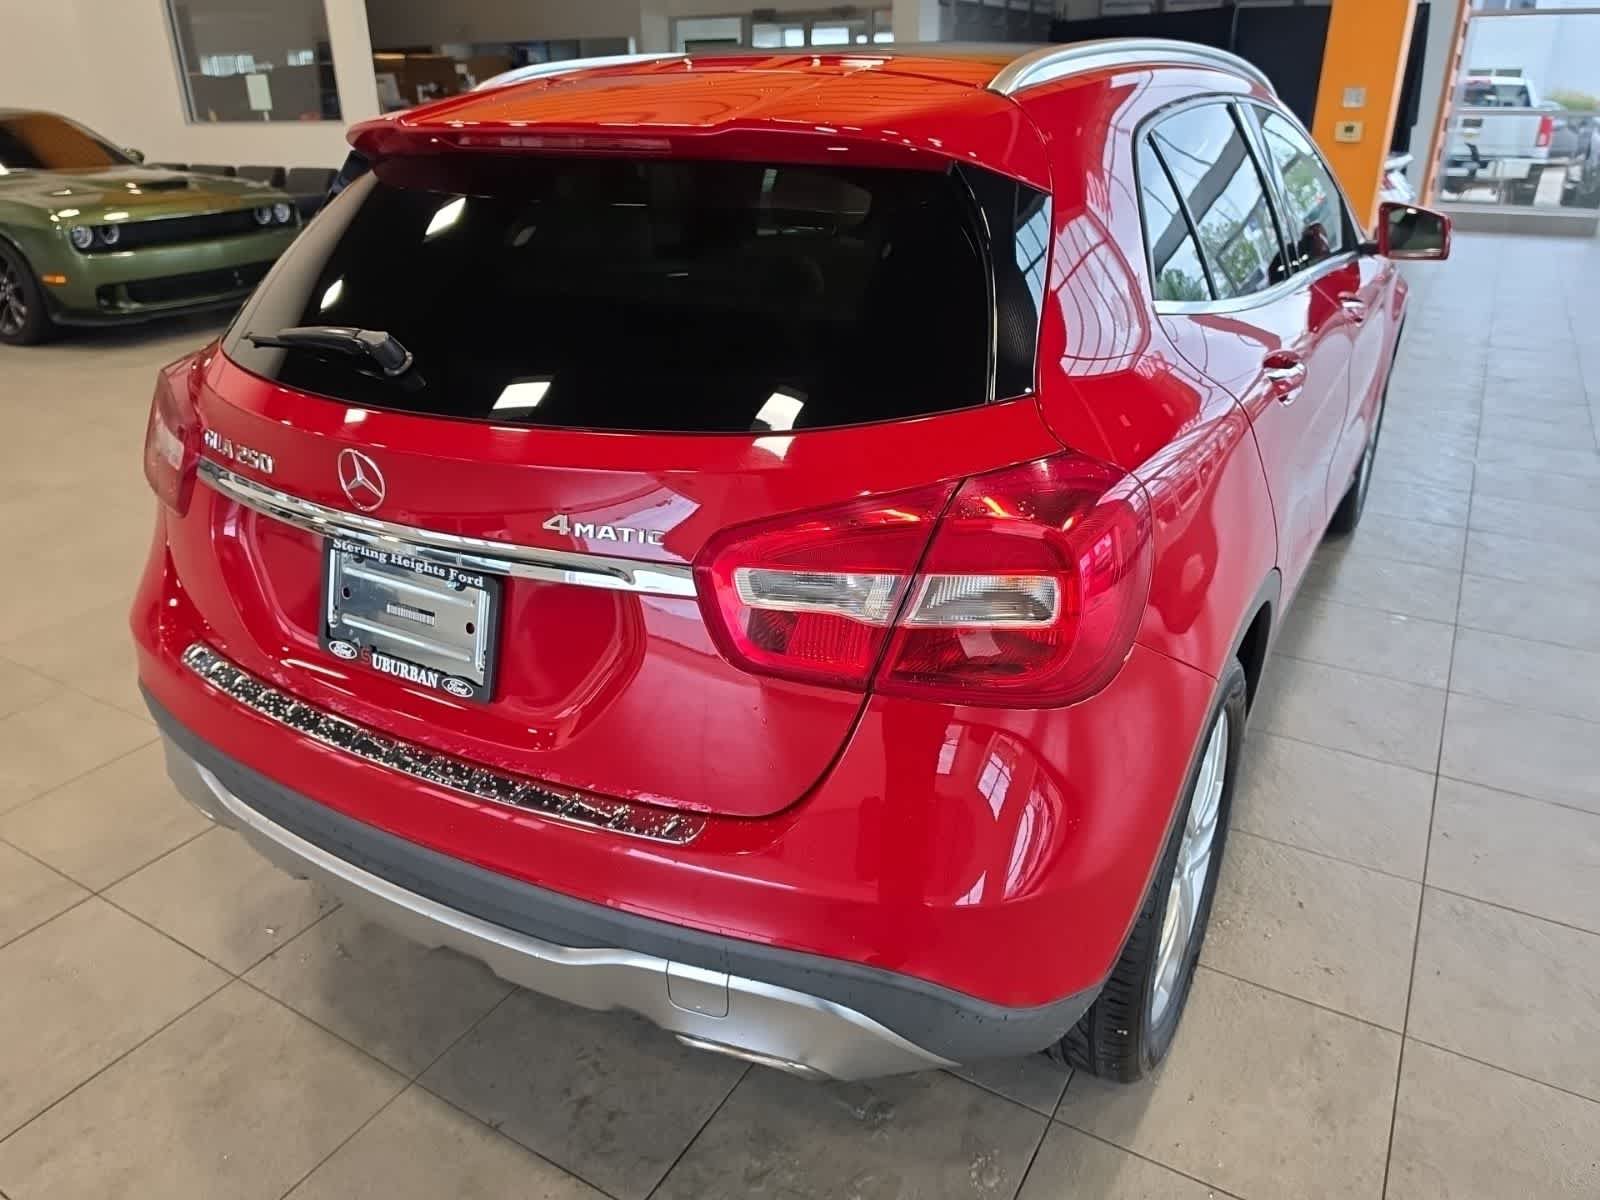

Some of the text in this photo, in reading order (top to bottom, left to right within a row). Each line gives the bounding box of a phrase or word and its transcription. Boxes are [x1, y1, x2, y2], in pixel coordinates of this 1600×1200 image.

[236, 445, 273, 474] 250
[542, 514, 666, 546] 4MATIC
[332, 537, 484, 587] Sterling Heights Ford
